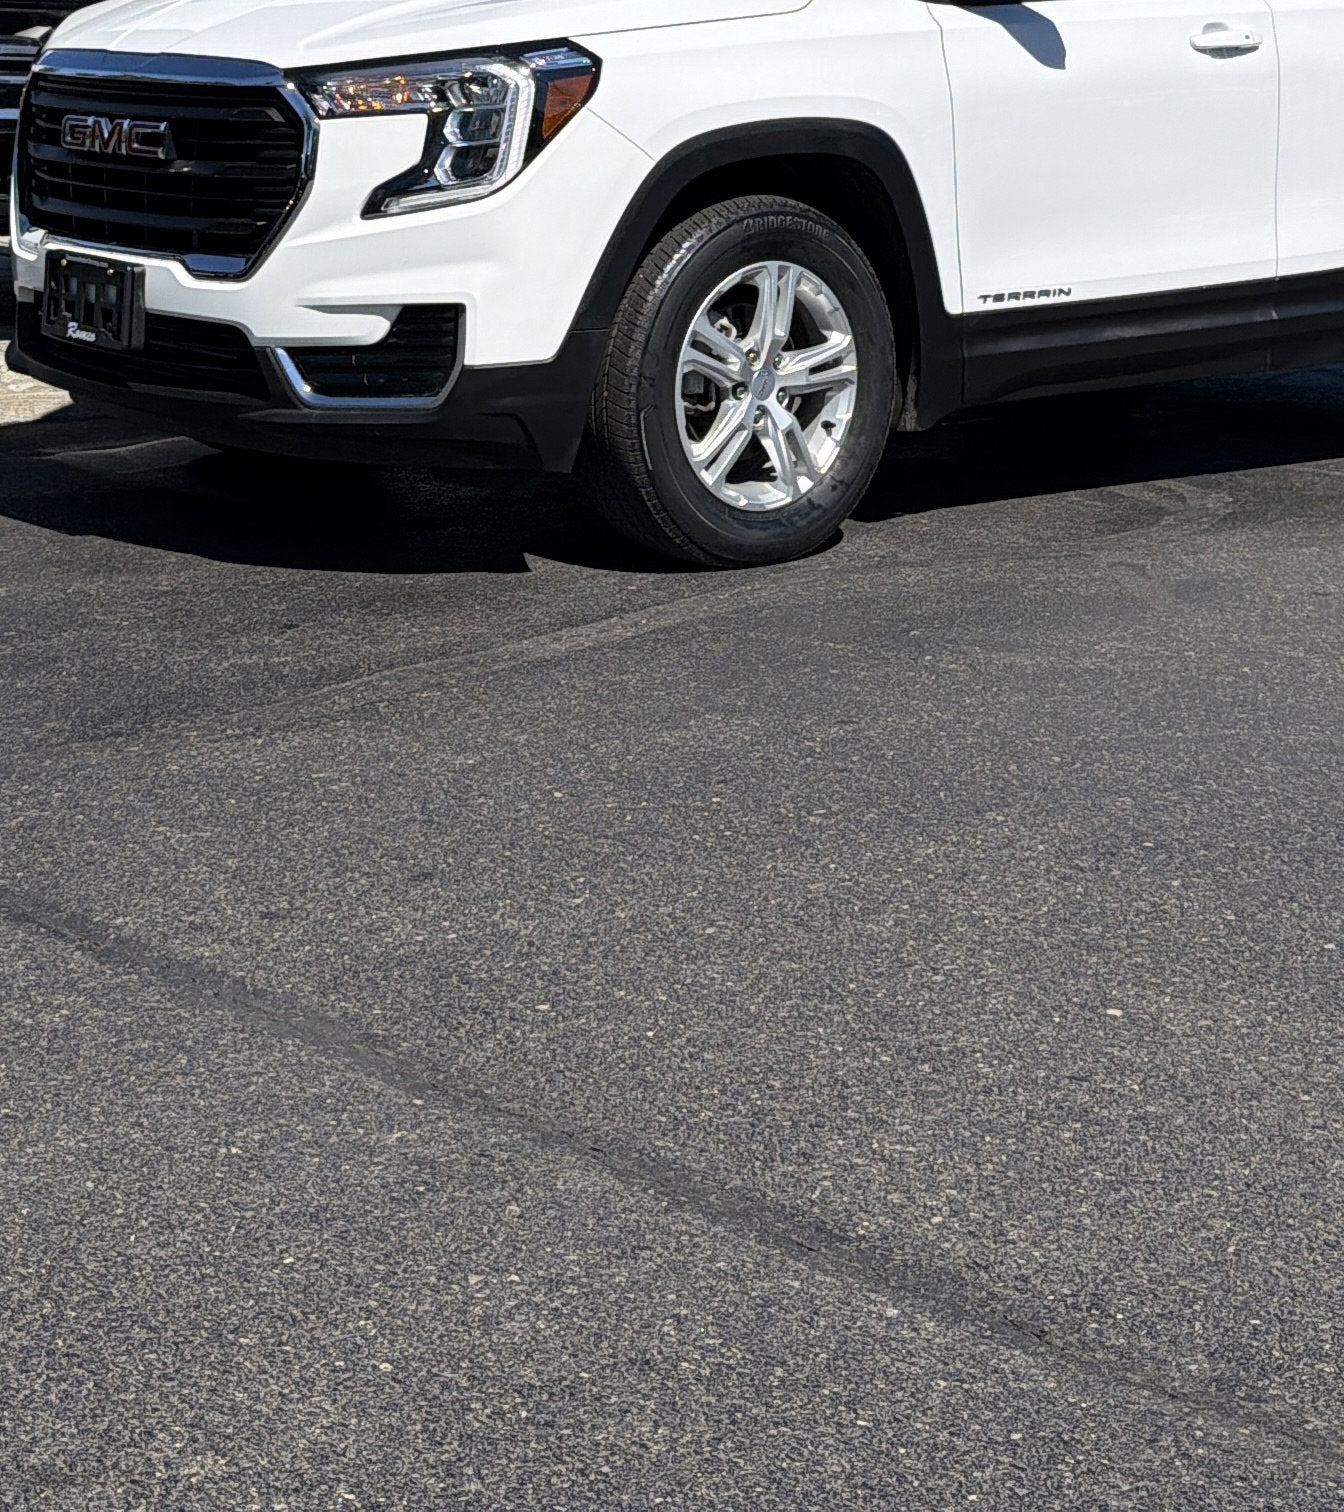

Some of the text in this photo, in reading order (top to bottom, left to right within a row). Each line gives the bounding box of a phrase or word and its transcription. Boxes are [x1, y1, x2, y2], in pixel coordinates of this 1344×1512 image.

[61, 114, 167, 159] GMC
[742, 214, 831, 241] BRIDGESTONE
[977, 287, 1072, 305] TERRAIN
